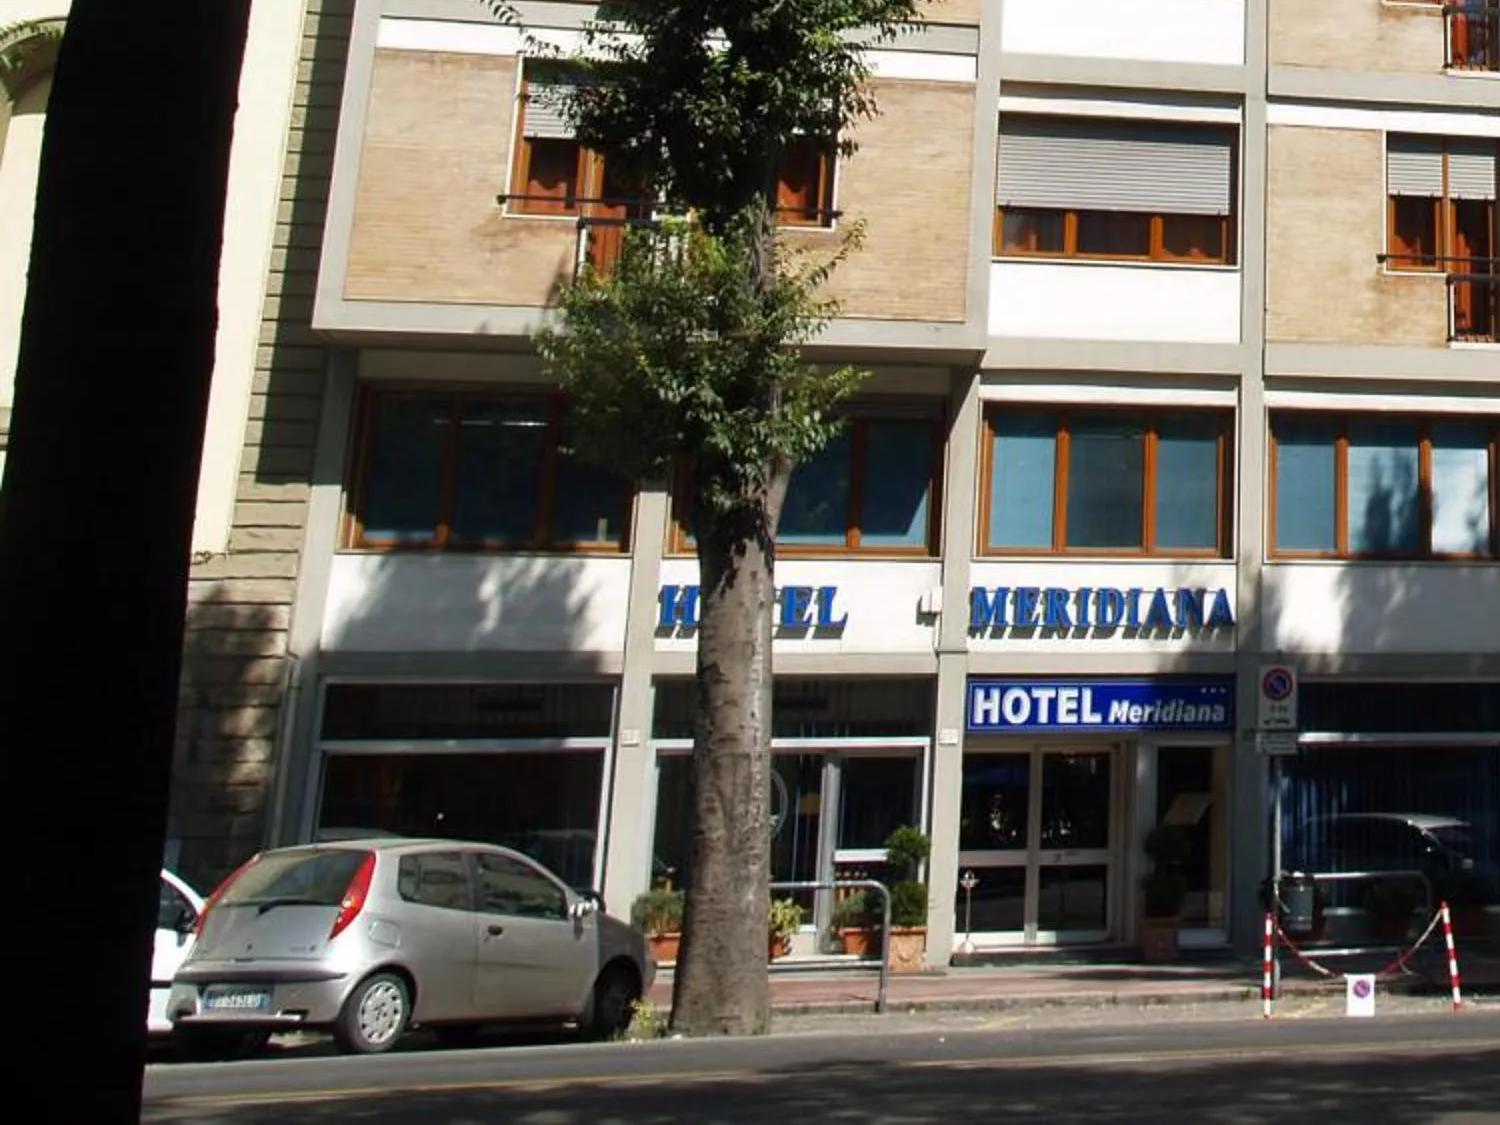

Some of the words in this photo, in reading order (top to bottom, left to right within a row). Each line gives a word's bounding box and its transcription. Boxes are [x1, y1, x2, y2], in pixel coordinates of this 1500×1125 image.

[659, 586, 848, 627] HEL
[972, 586, 1235, 628] MERIDIANA
[973, 687, 1102, 724] HOTEL
[1108, 699, 1225, 723] Meridiana
